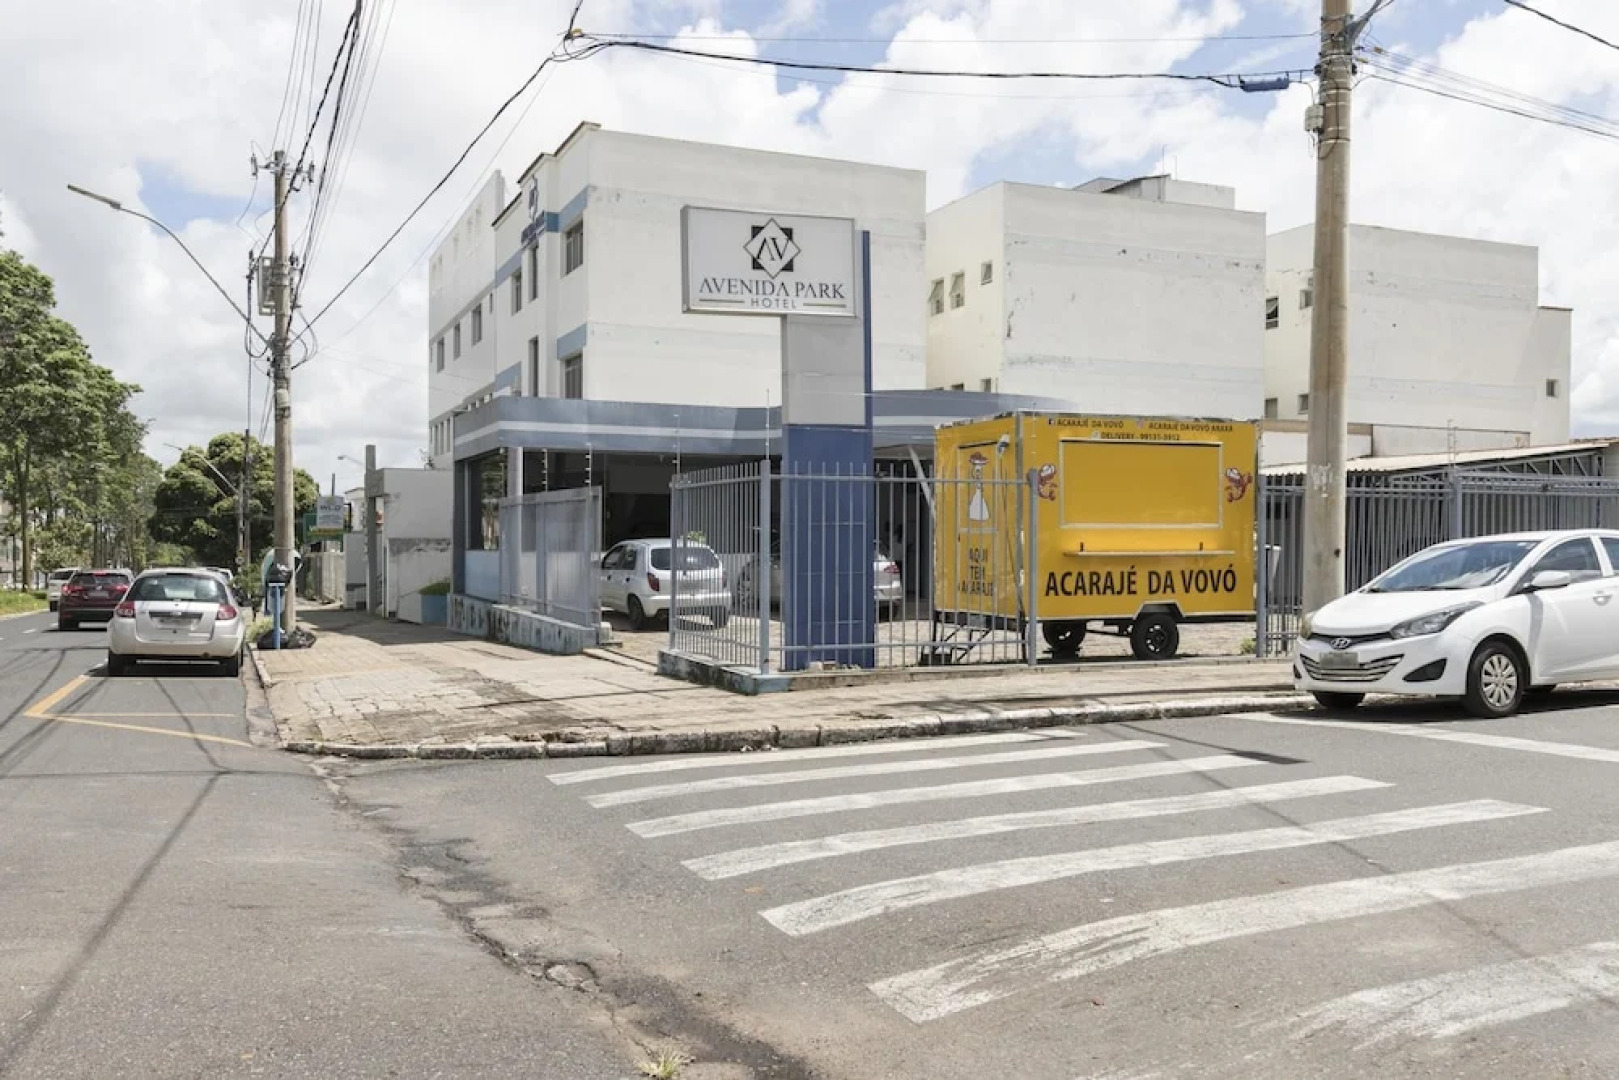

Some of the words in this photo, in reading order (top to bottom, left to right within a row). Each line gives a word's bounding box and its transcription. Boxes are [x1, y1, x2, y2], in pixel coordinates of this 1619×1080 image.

[699, 277, 790, 297] AVENIDA
[794, 281, 845, 299] PARK
[751, 297, 796, 309] HOTEL
[1091, 420, 1102, 428] DA
[1101, 431, 1134, 440] DELIVERY
[1045, 564, 1138, 597] ACARAJÉ
[1147, 569, 1176, 595] DA
[1180, 563, 1237, 594] VOVÓ
